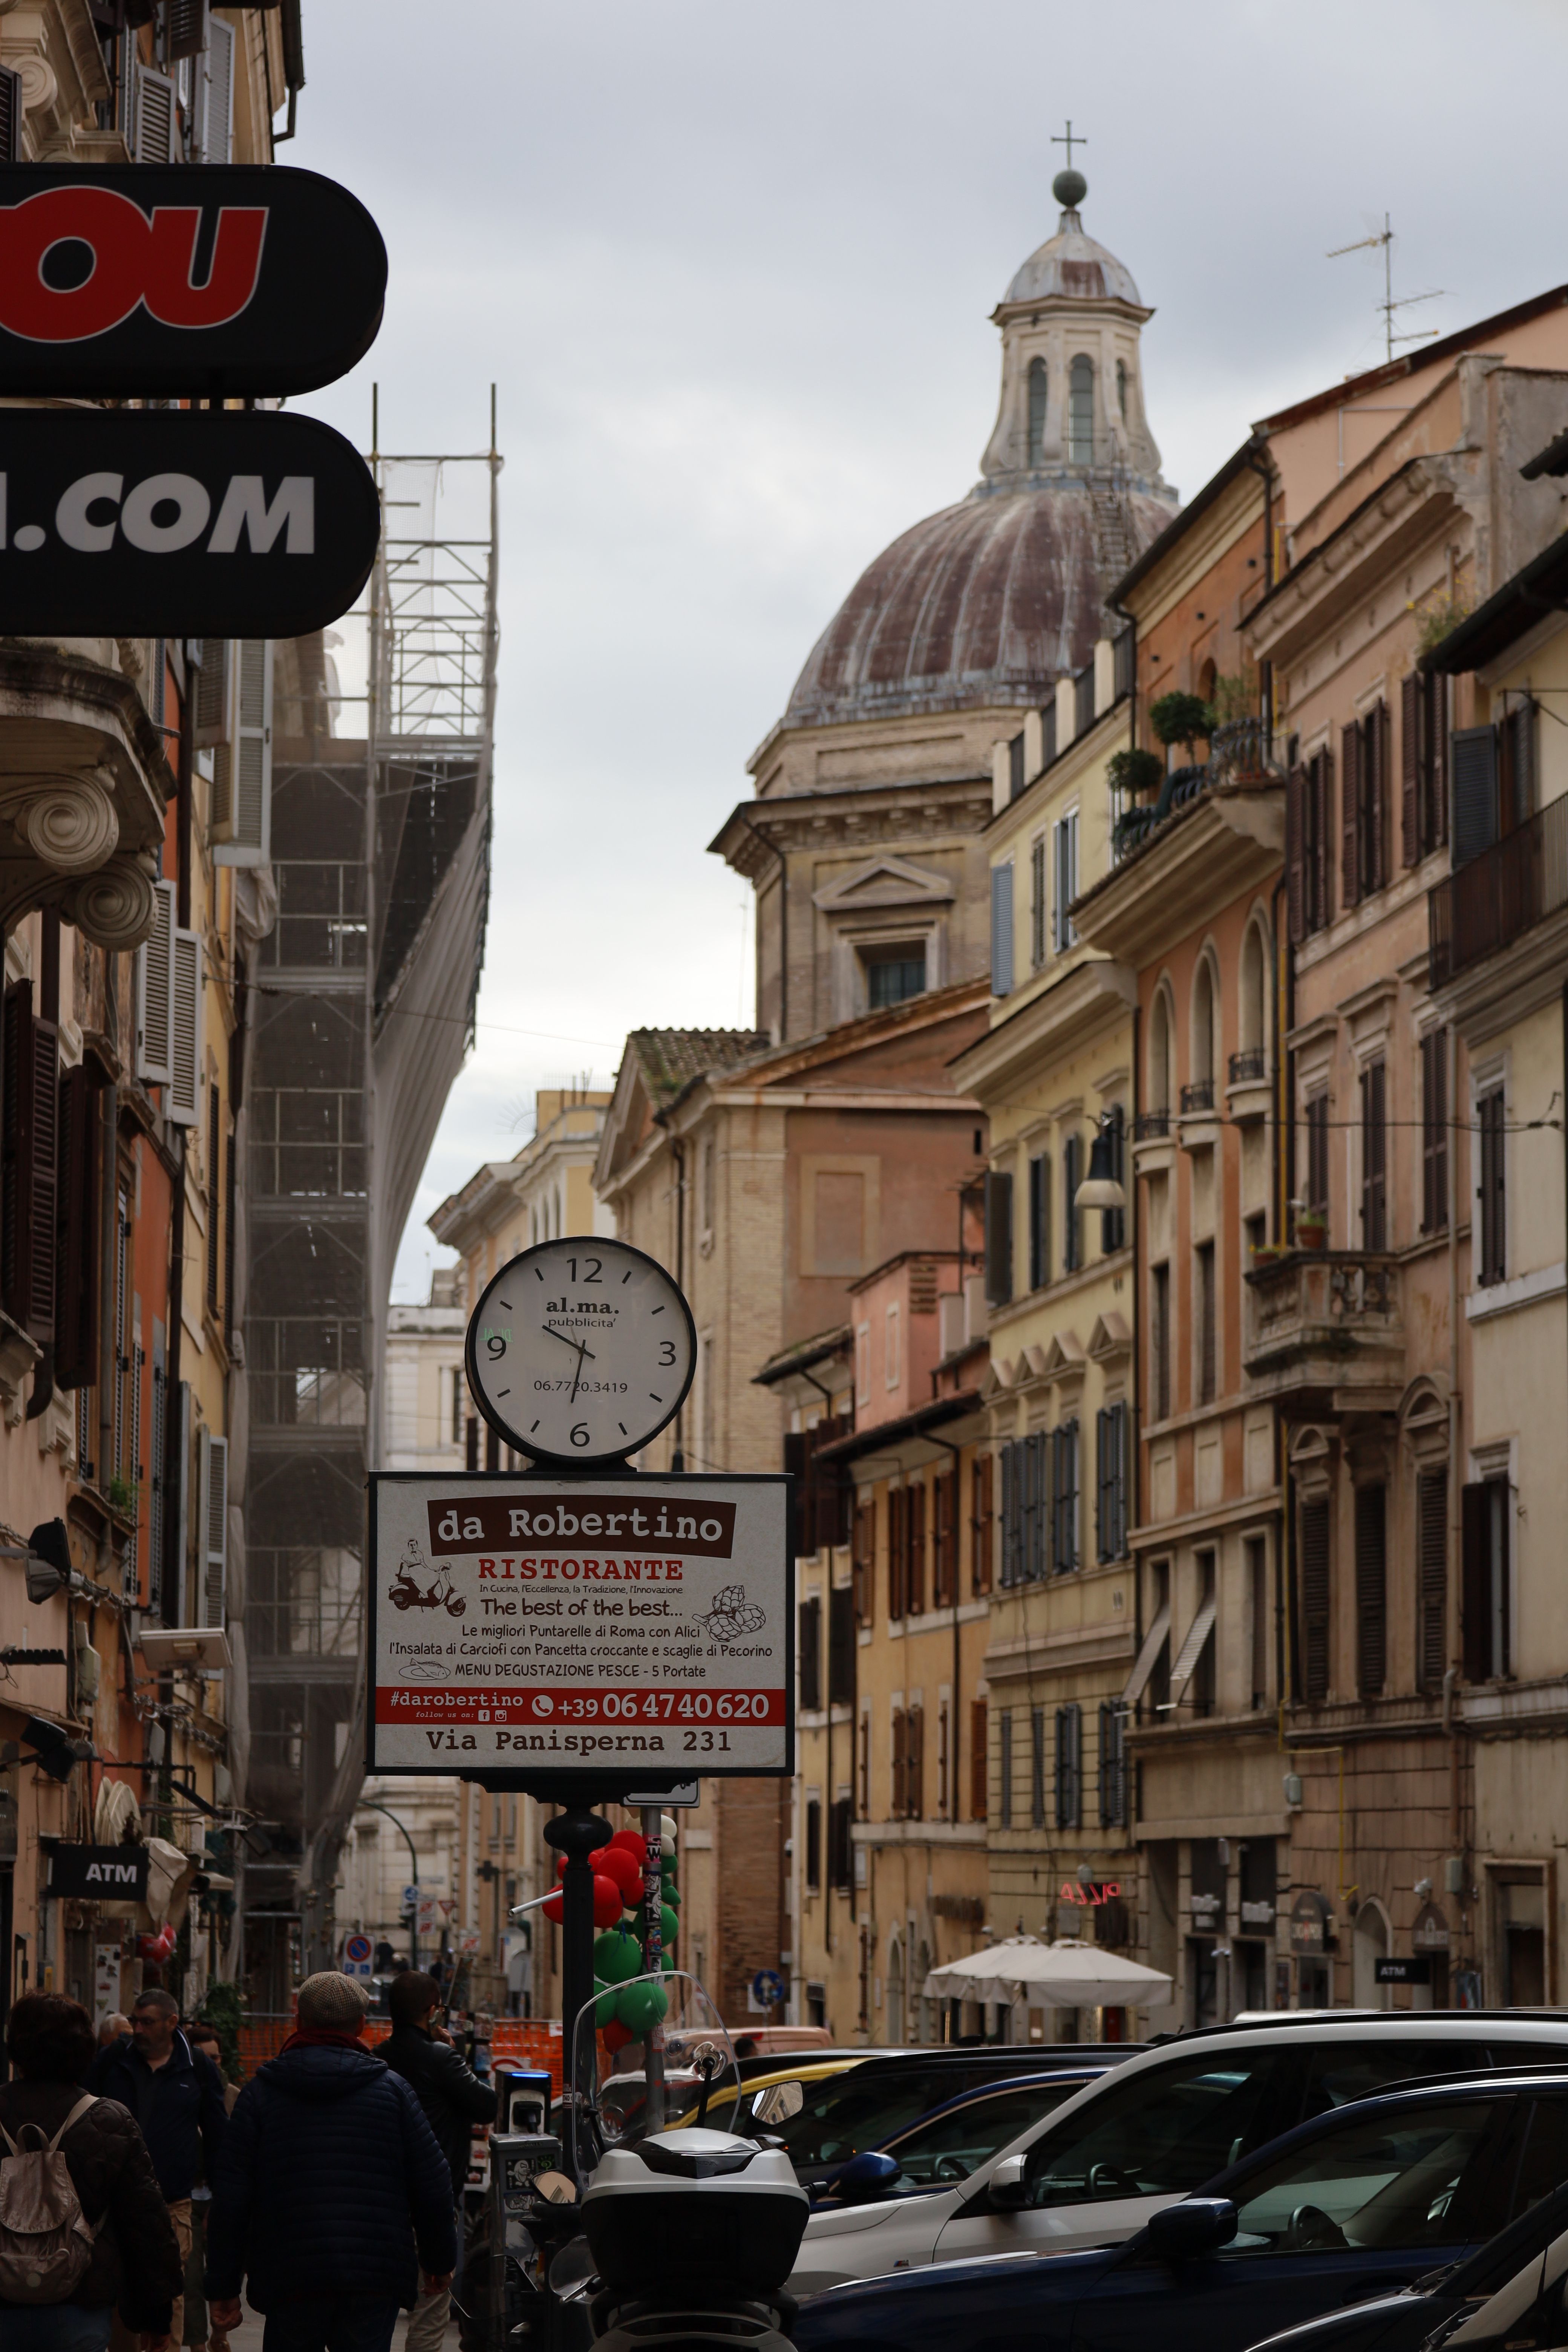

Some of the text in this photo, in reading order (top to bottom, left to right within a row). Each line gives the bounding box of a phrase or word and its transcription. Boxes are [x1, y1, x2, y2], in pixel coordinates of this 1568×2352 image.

[0, 185, 269, 343] OU
[0, 471, 314, 554] .COM
[566, 1258, 603, 1283] 12
[546, 1297, 619, 1314] al.ma.
[487, 1336, 507, 1361] 9
[658, 1341, 677, 1366] 3
[534, 1380, 628, 1393] 06.7720.3419
[570, 1423, 591, 1447] 6
[438, 1505, 722, 1541] da Robertino
[478, 1559, 683, 1580] RISTORANTE
[490, 1585, 519, 1594] Cucina,
[522, 1585, 571, 1594] l'Eccellenza,
[582, 1585, 628, 1594] Tradizione,
[630, 1585, 683, 1594] l'Innovazione
[480, 1597, 682, 1616] The best of the best...
[462, 1624, 700, 1640] Le migliori Puntarelle di Roma con Alici
[390, 1642, 772, 1659] l'Insalata di Carciofi con Pancetta croccante e scaglie di Pecorino
[455, 1664, 491, 1676] MENU
[495, 1664, 594, 1677] DEGUSTAZIONE
[598, 1664, 640, 1677] PESCE
[652, 1665, 659, 1677] 5
[663, 1665, 706, 1677] Portate
[390, 1691, 523, 1706] #darobertino
[426, 1729, 731, 1756] Via Panisperna 231
[85, 1863, 137, 1883] ATM
[1381, 1965, 1406, 1976] ATM
